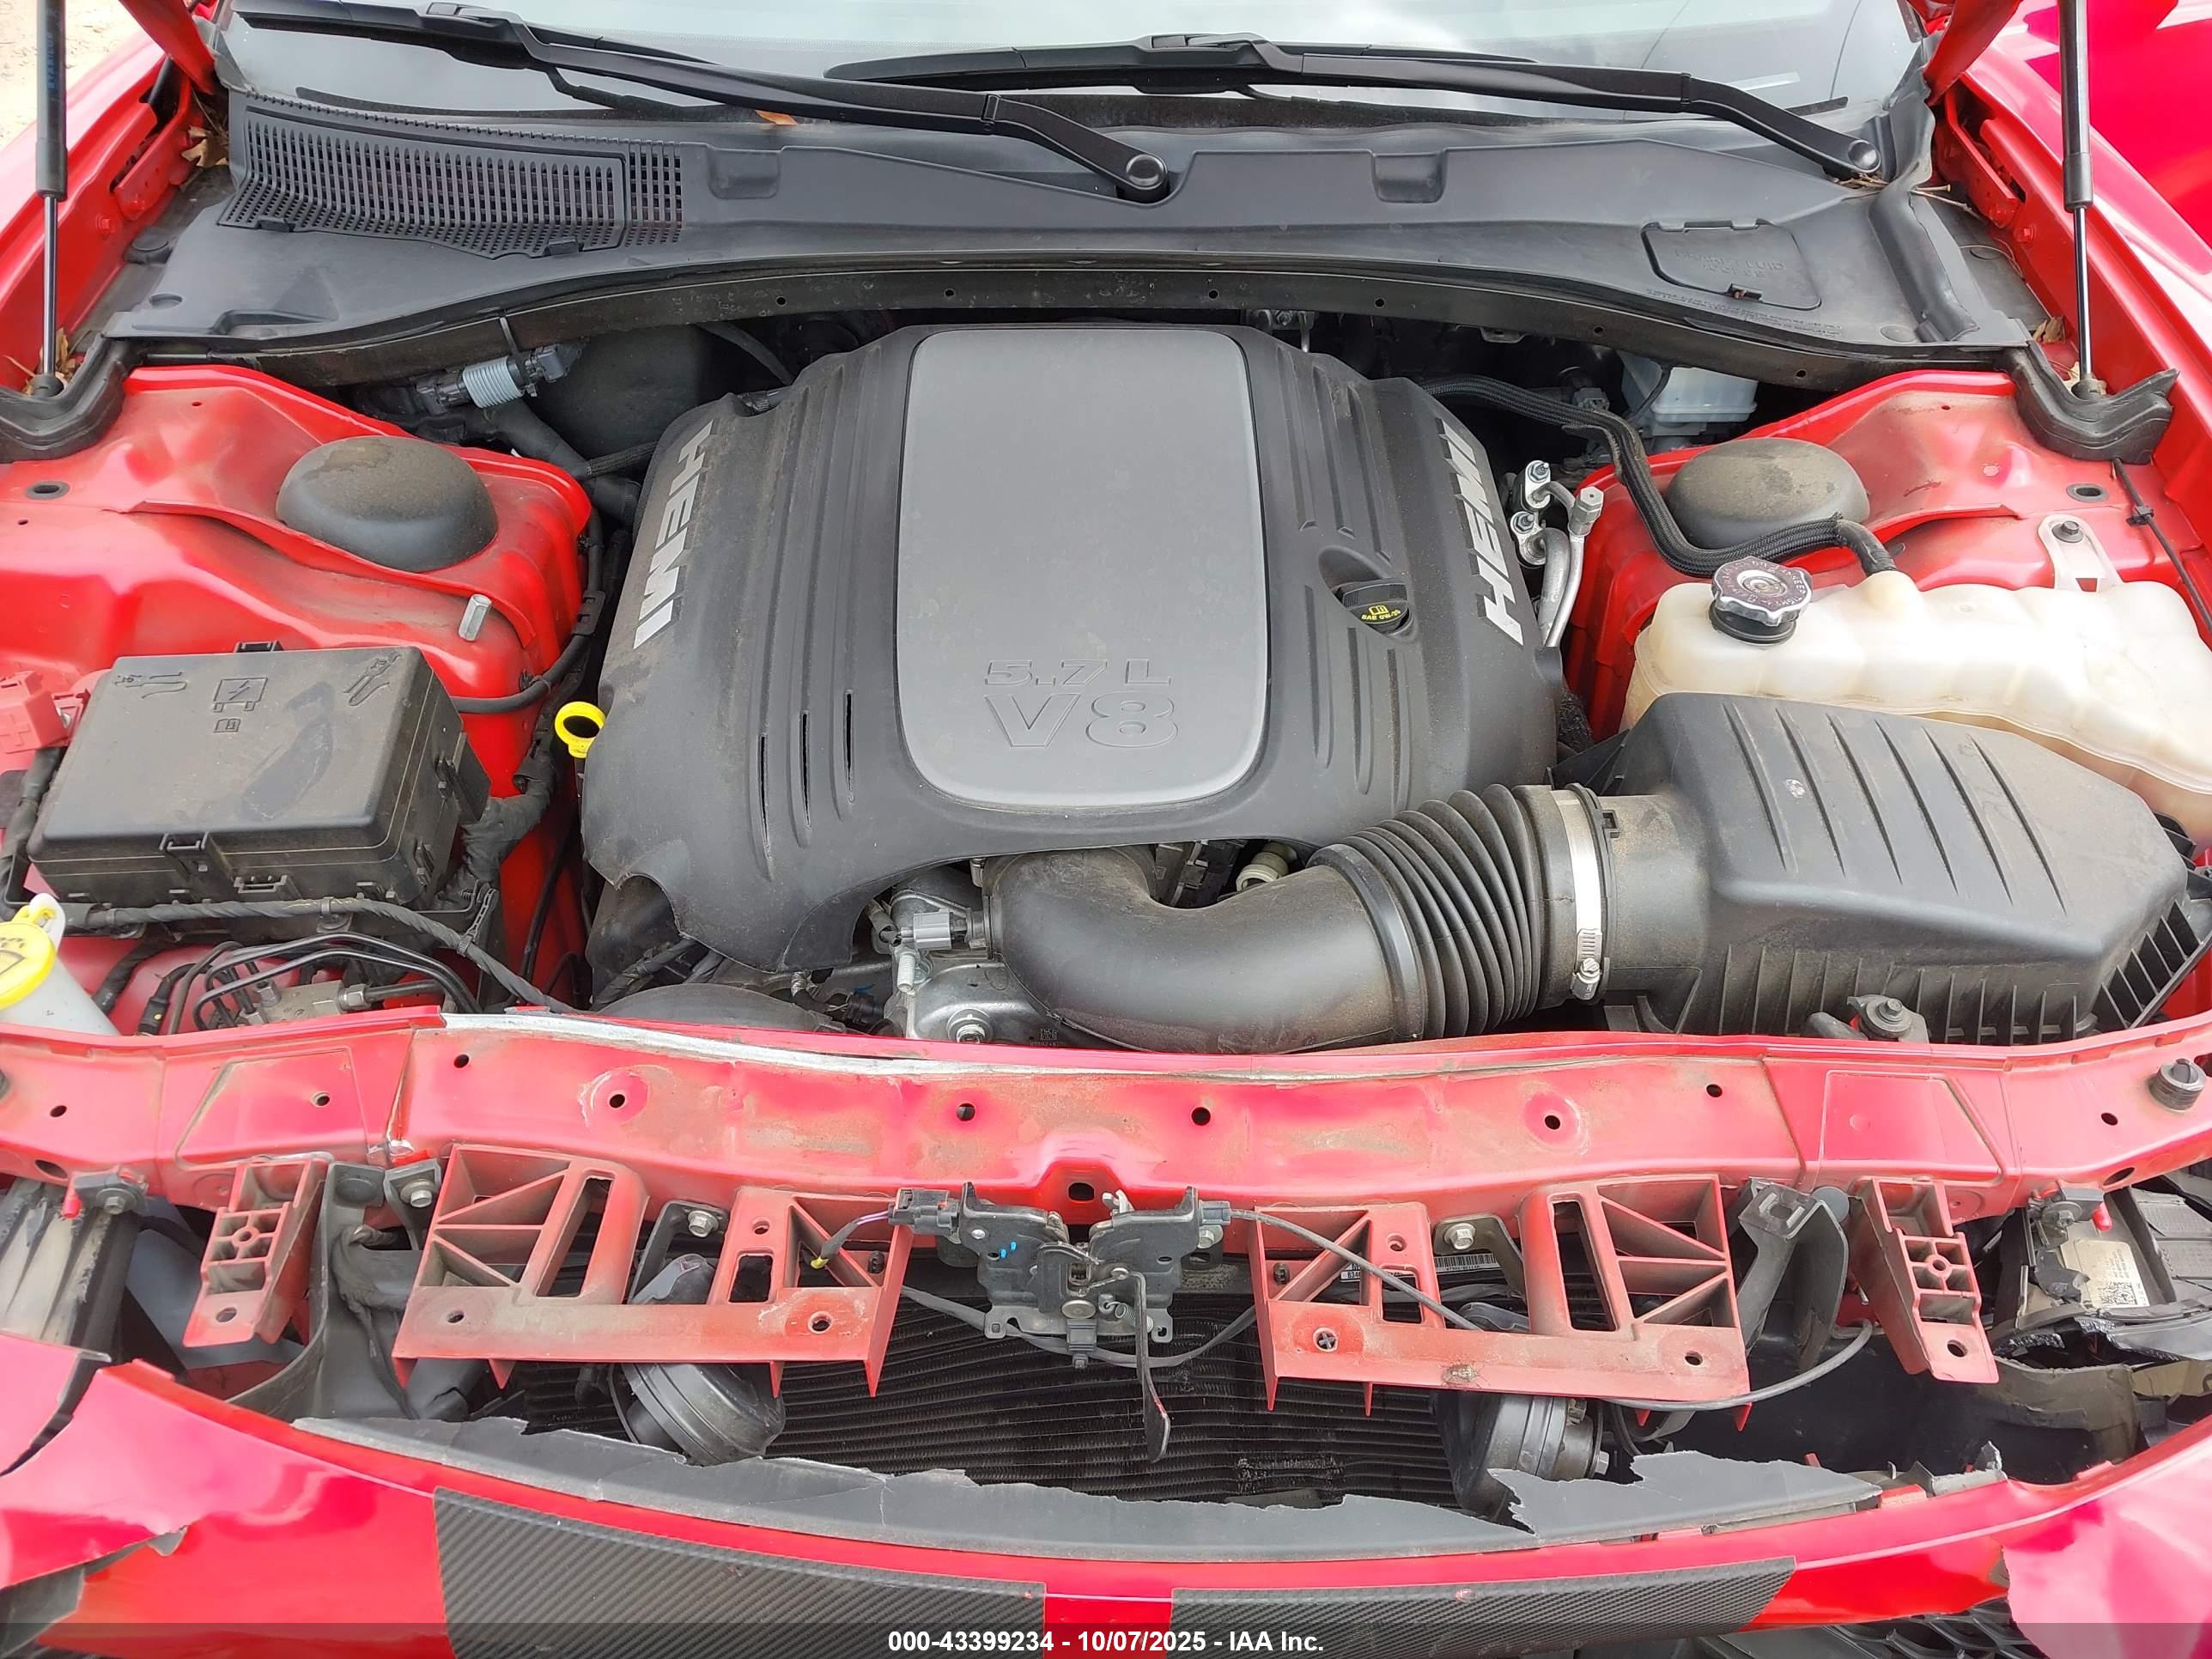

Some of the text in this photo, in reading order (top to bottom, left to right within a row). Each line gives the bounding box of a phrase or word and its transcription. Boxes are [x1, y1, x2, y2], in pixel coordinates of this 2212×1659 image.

[634, 419, 714, 649] HEMI
[1440, 418, 1524, 646] HEMI
[983, 690, 1179, 749] V8
